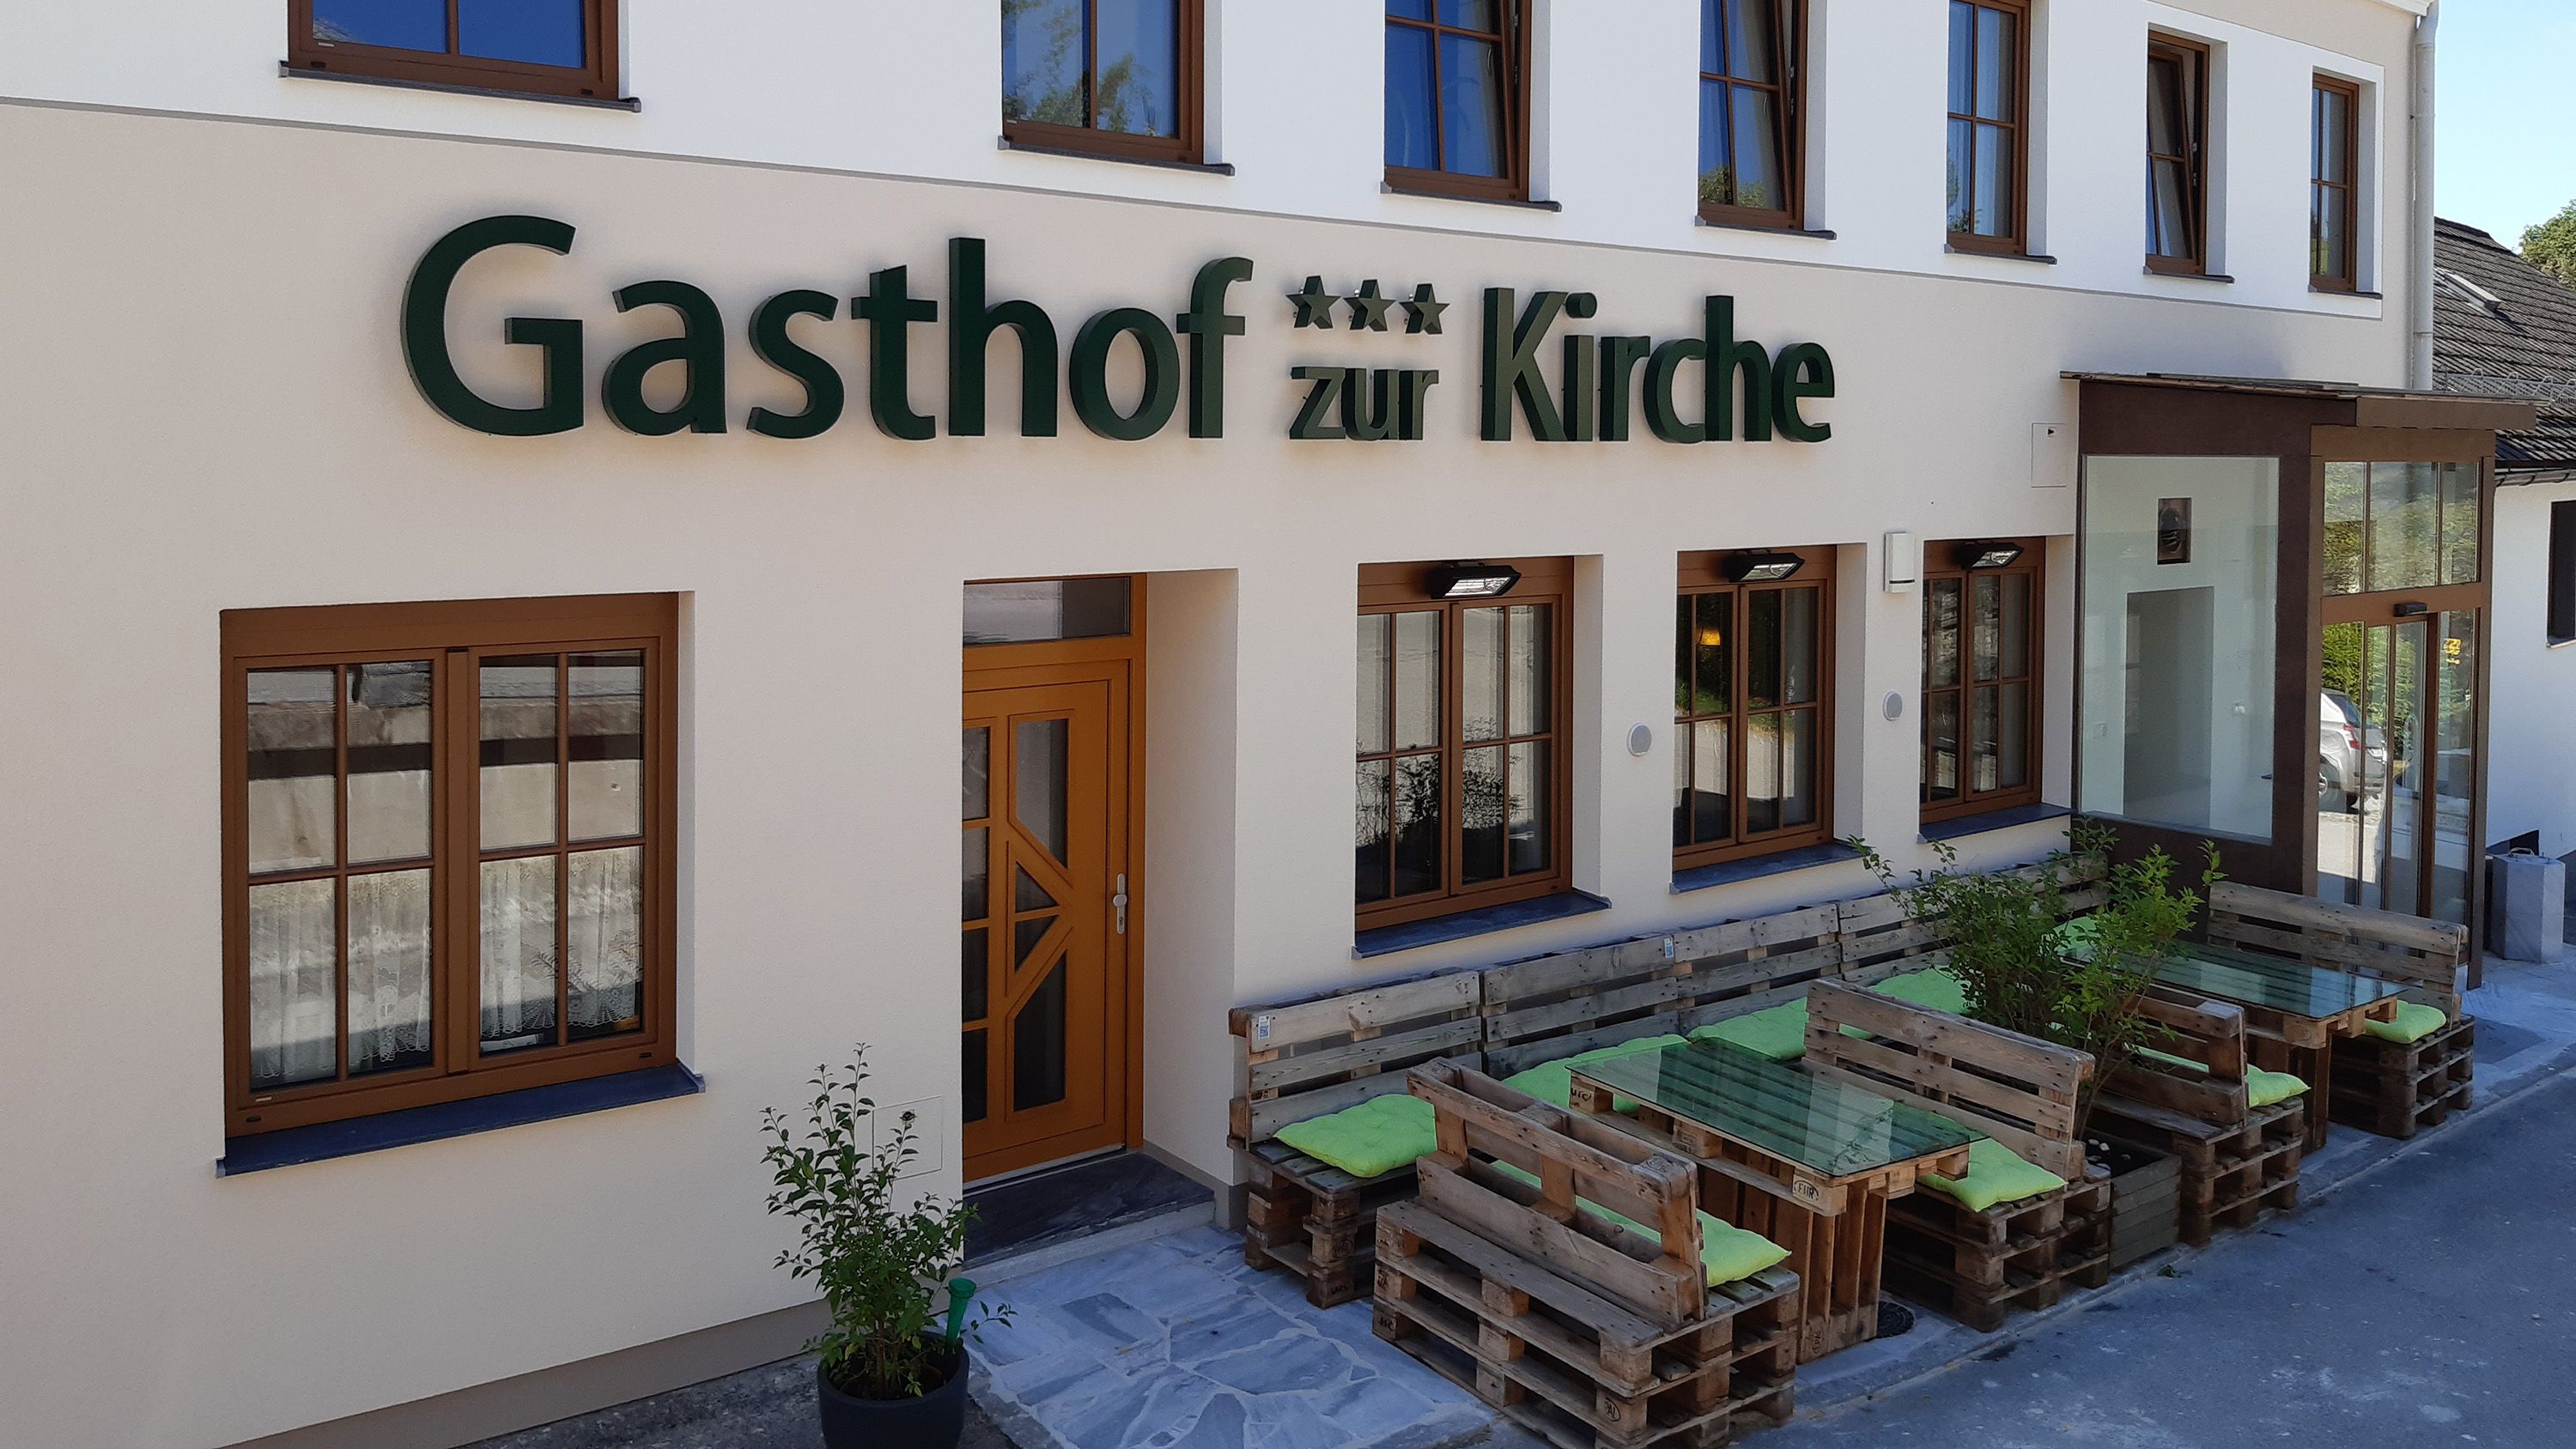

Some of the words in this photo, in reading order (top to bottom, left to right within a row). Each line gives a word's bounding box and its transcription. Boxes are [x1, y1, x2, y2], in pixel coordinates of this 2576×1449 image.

[399, 214, 1254, 441] Gasthof
[1289, 366, 1439, 440] zur
[1480, 288, 1835, 443] Kirche
